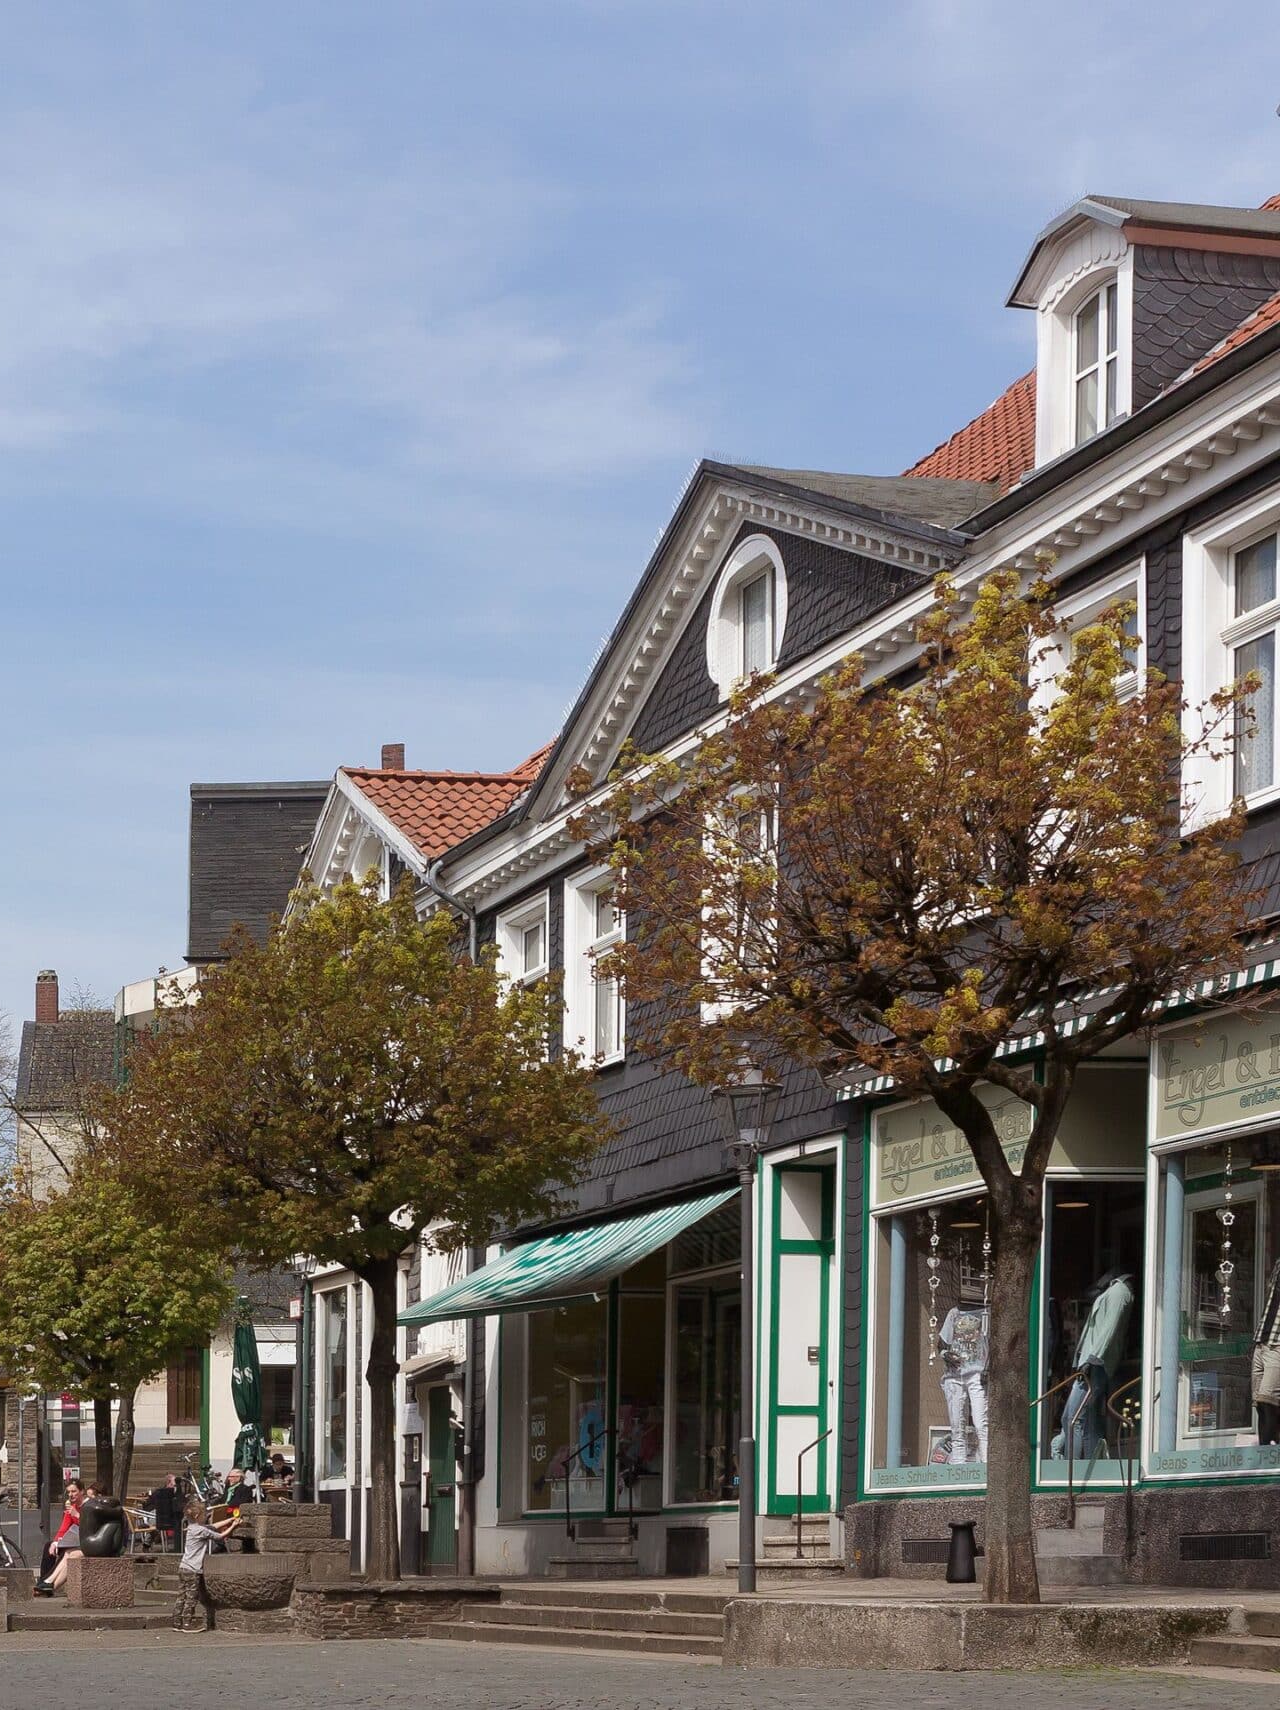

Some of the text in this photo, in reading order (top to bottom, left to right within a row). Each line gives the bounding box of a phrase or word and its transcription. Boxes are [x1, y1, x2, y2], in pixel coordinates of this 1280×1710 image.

[1162, 1034, 1228, 1127] Engel
[1236, 1040, 1261, 1083] &
[879, 1118, 925, 1194] Engel
[931, 1124, 949, 1160] &
[876, 1472, 898, 1486] Jeans
[907, 1470, 938, 1484] Schuhe
[946, 1467, 981, 1481] T-Shirts
[1156, 1456, 1188, 1471] Jeans
[1200, 1452, 1243, 1469] Schuhe
